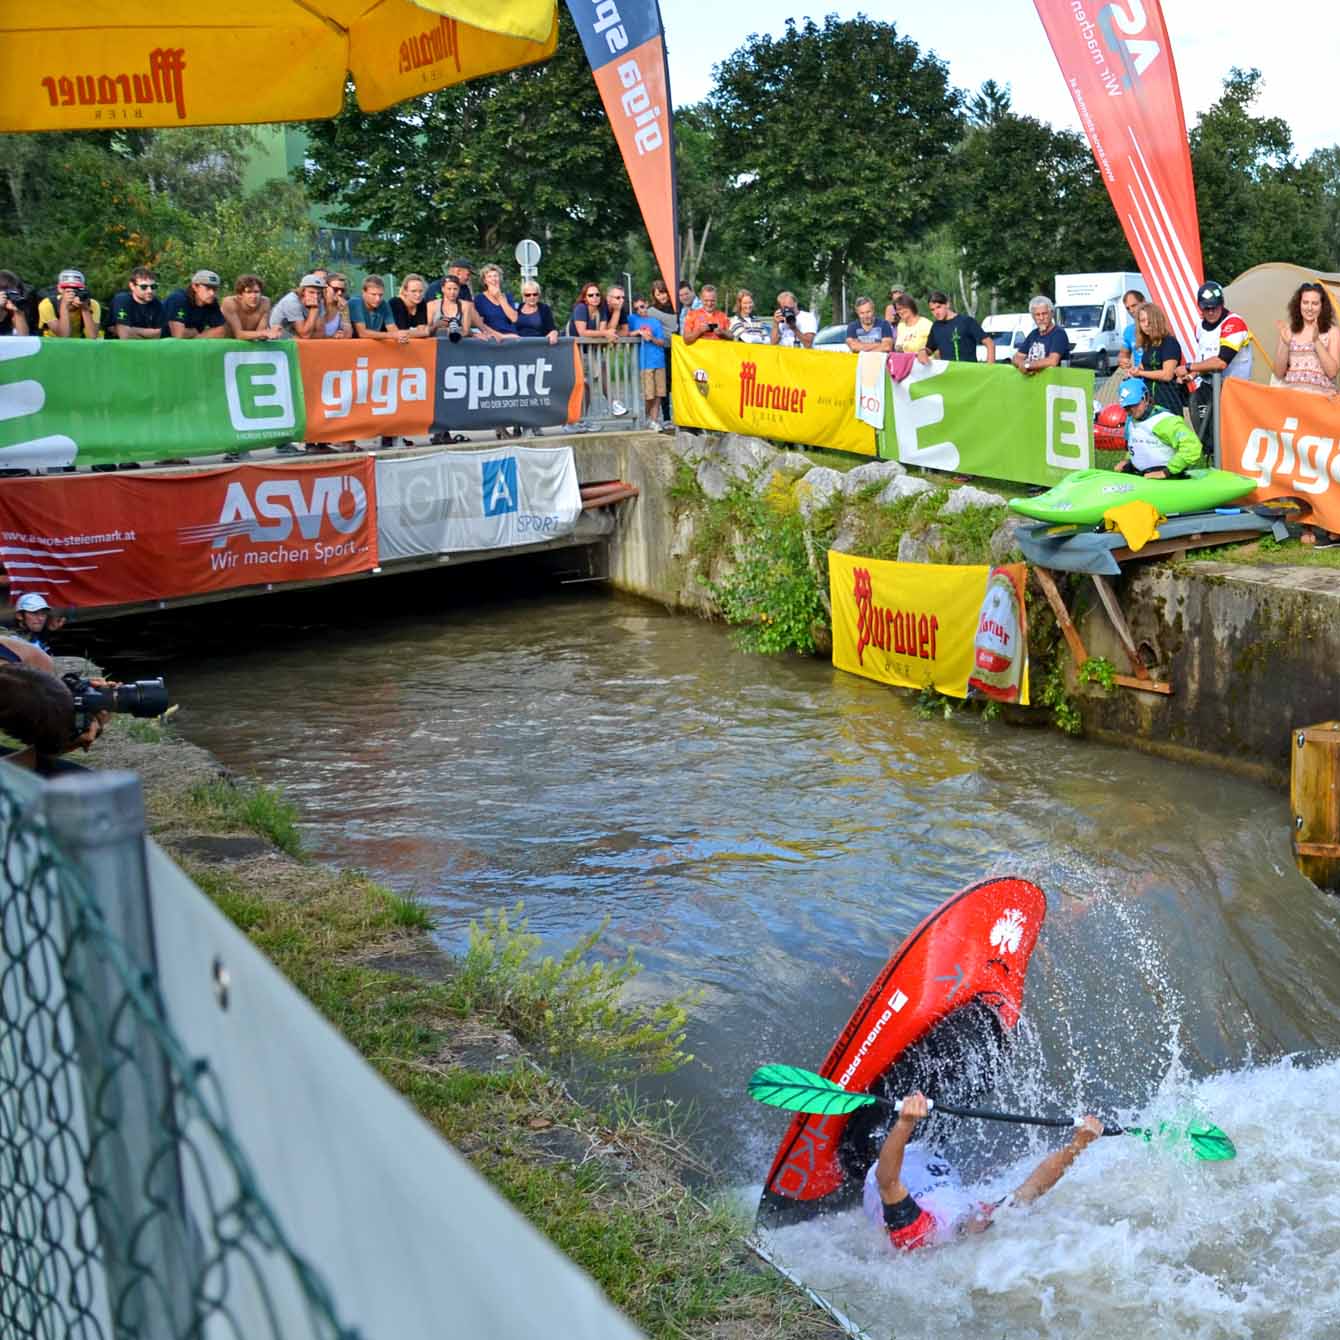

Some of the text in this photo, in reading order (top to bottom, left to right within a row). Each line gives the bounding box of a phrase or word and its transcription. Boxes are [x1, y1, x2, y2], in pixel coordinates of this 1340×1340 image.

[321, 357, 552, 419] giga sport
[739, 361, 807, 418] Murauer
[211, 475, 368, 549] ASVÖ
[517, 514, 561, 532] SPORT
[211, 551, 240, 571] Wir
[244, 545, 309, 566] machen
[853, 567, 939, 667] Murauer
